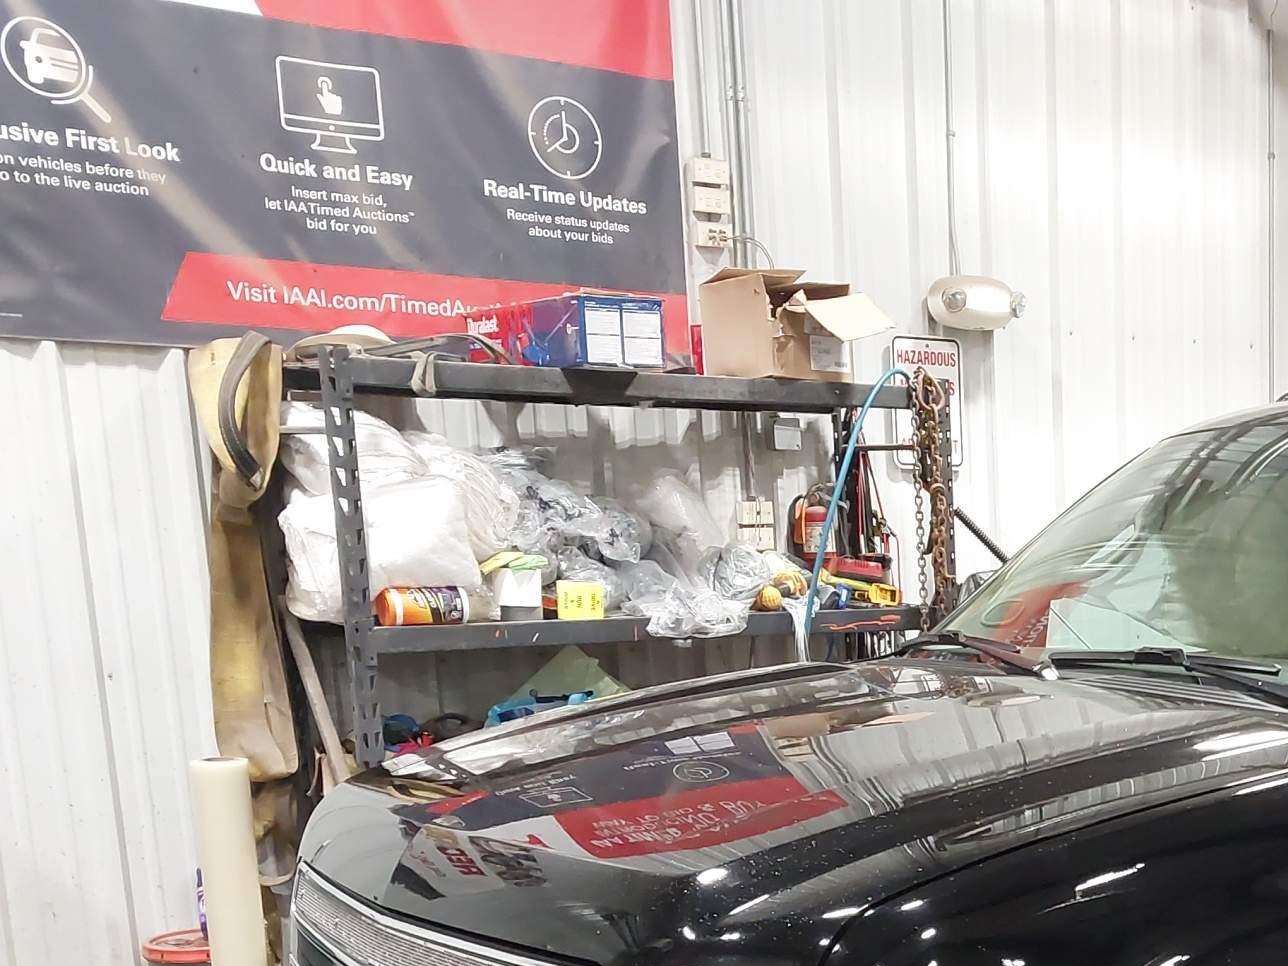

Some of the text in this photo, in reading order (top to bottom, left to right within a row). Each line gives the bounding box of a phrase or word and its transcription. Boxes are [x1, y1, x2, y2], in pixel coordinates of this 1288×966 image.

[65, 128, 120, 153] First
[125, 137, 181, 162] Look
[18, 155, 82, 173] vehicles
[86, 161, 134, 178] before
[137, 168, 167, 185] they
[259, 153, 413, 191] Quick and Easy
[14, 170, 31, 183] to
[34, 172, 60, 186] the
[64, 175, 91, 190] live
[95, 180, 149, 196] auction
[264, 196, 281, 210] let
[291, 185, 388, 208] Insert max bid,
[483, 178, 648, 215] Real-Time Updates
[306, 217, 377, 236] bid for you
[506, 208, 631, 233] Receive status updates
[528, 226, 614, 245] about your bids
[226, 280, 277, 304] Visit
[896, 349, 957, 368] HAZARDOUS
